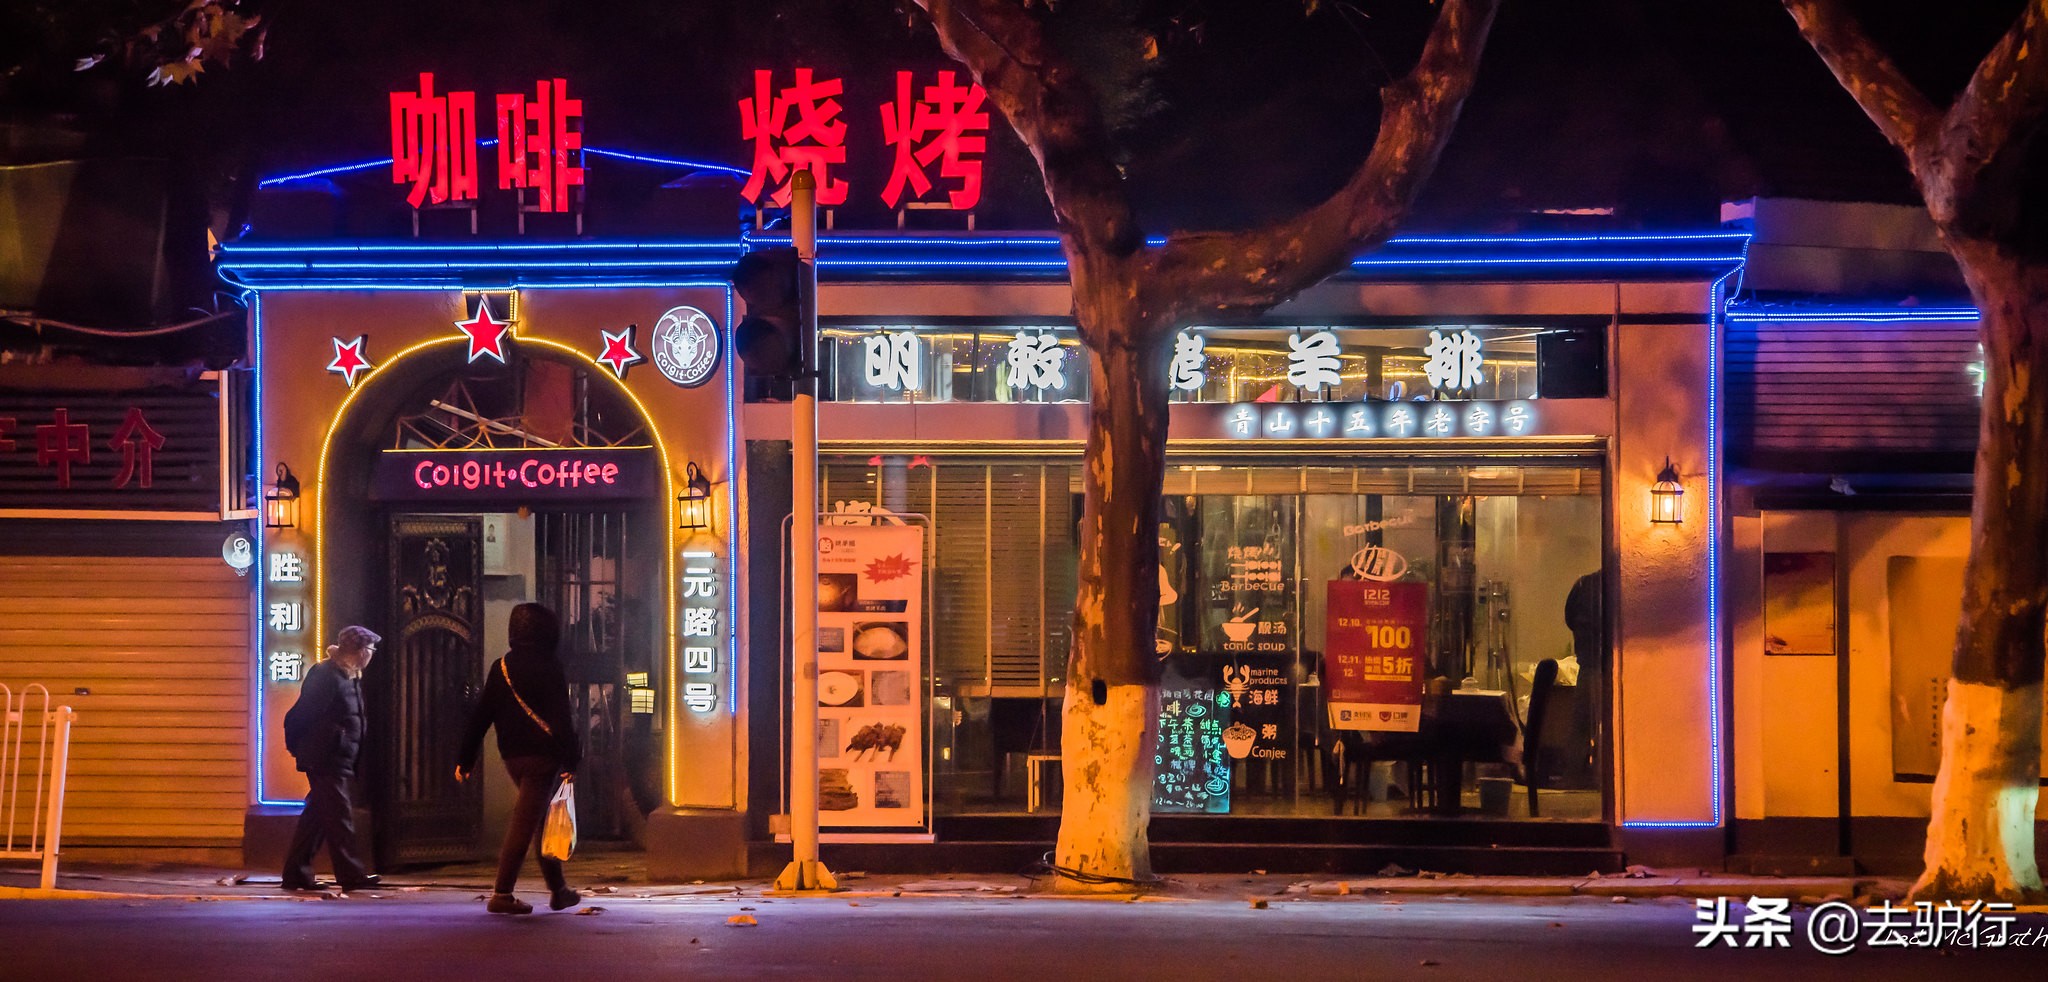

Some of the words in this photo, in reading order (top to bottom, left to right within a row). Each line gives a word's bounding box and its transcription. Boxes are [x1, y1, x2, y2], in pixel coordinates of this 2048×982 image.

[389, 72, 584, 213] 咖啡
[738, 68, 990, 210] 烧烤
[1229, 406, 1529, 434] 青山十五年老字号
[0, 407, 167, 489] 中介
[1364, 589, 1390, 600] 1212
[269, 552, 303, 681] 胜利街
[682, 551, 718, 713] 一元路四号
[1258, 621, 1287, 635] 靓汤
[1365, 625, 1411, 649] 100
[1223, 640, 1254, 651] tonic
[1257, 643, 1285, 652] soup
[1250, 668, 1279, 676] marine
[1250, 677, 1288, 686] products
[1248, 689, 1279, 706] 海鲜
[1261, 723, 1278, 741] 粥
[1251, 745, 1287, 760] Conjee
